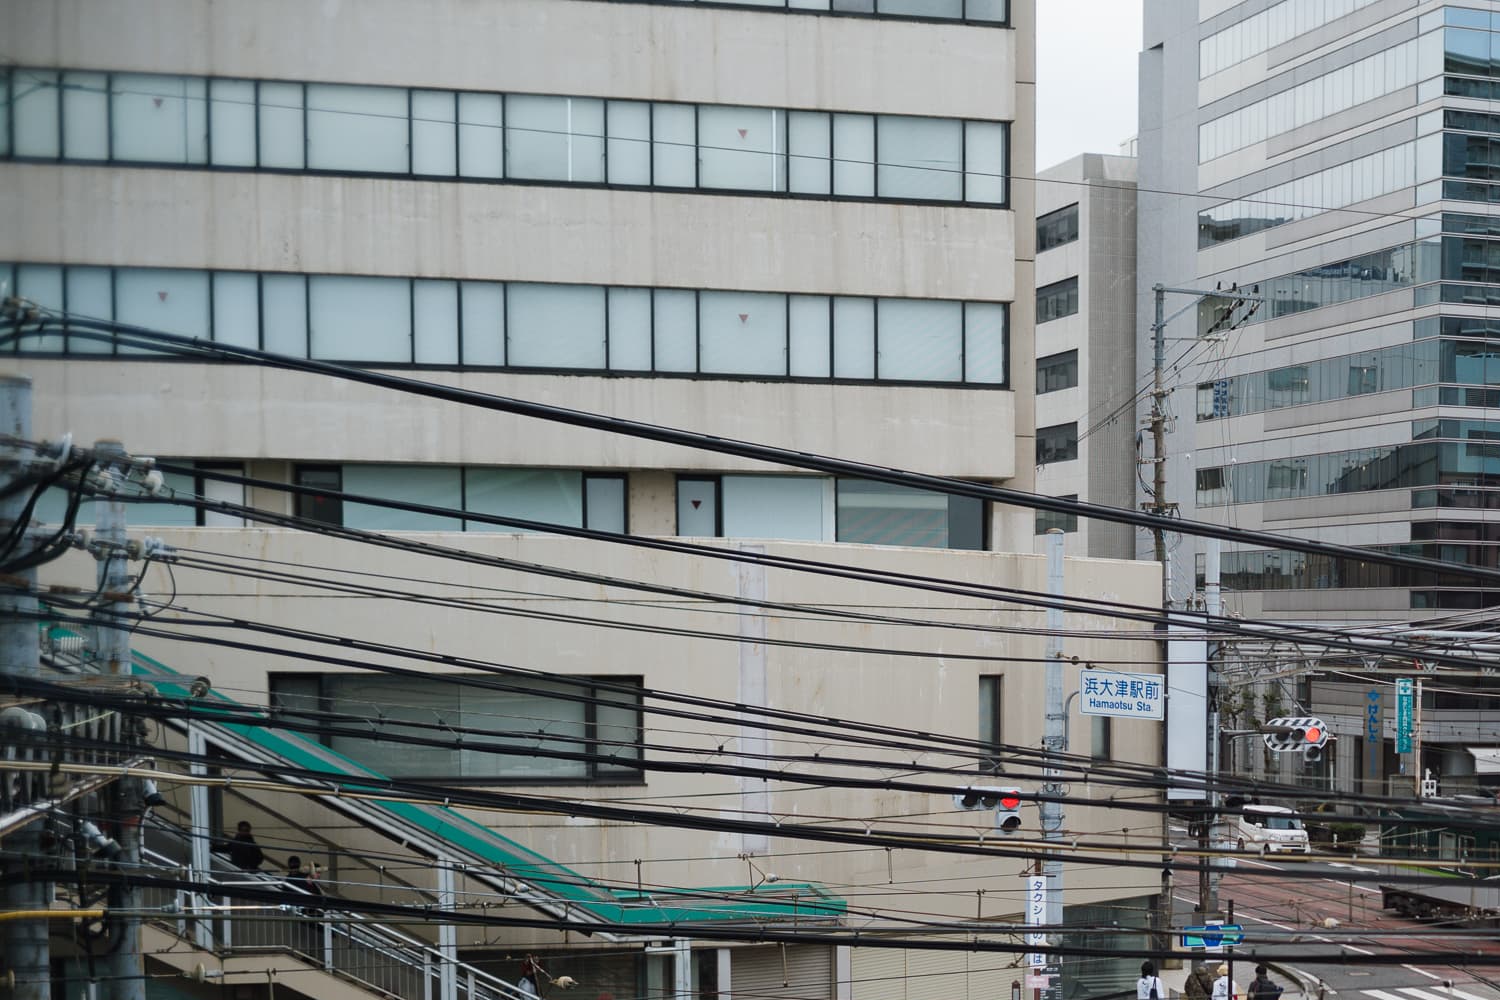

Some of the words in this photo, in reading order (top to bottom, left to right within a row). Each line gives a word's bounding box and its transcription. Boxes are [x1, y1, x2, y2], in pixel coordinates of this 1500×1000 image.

[1085, 677, 1159, 700] 浜大津駅前
[1089, 698, 1132, 711] Hamaotsu
[1137, 701, 1154, 712] Sta.
